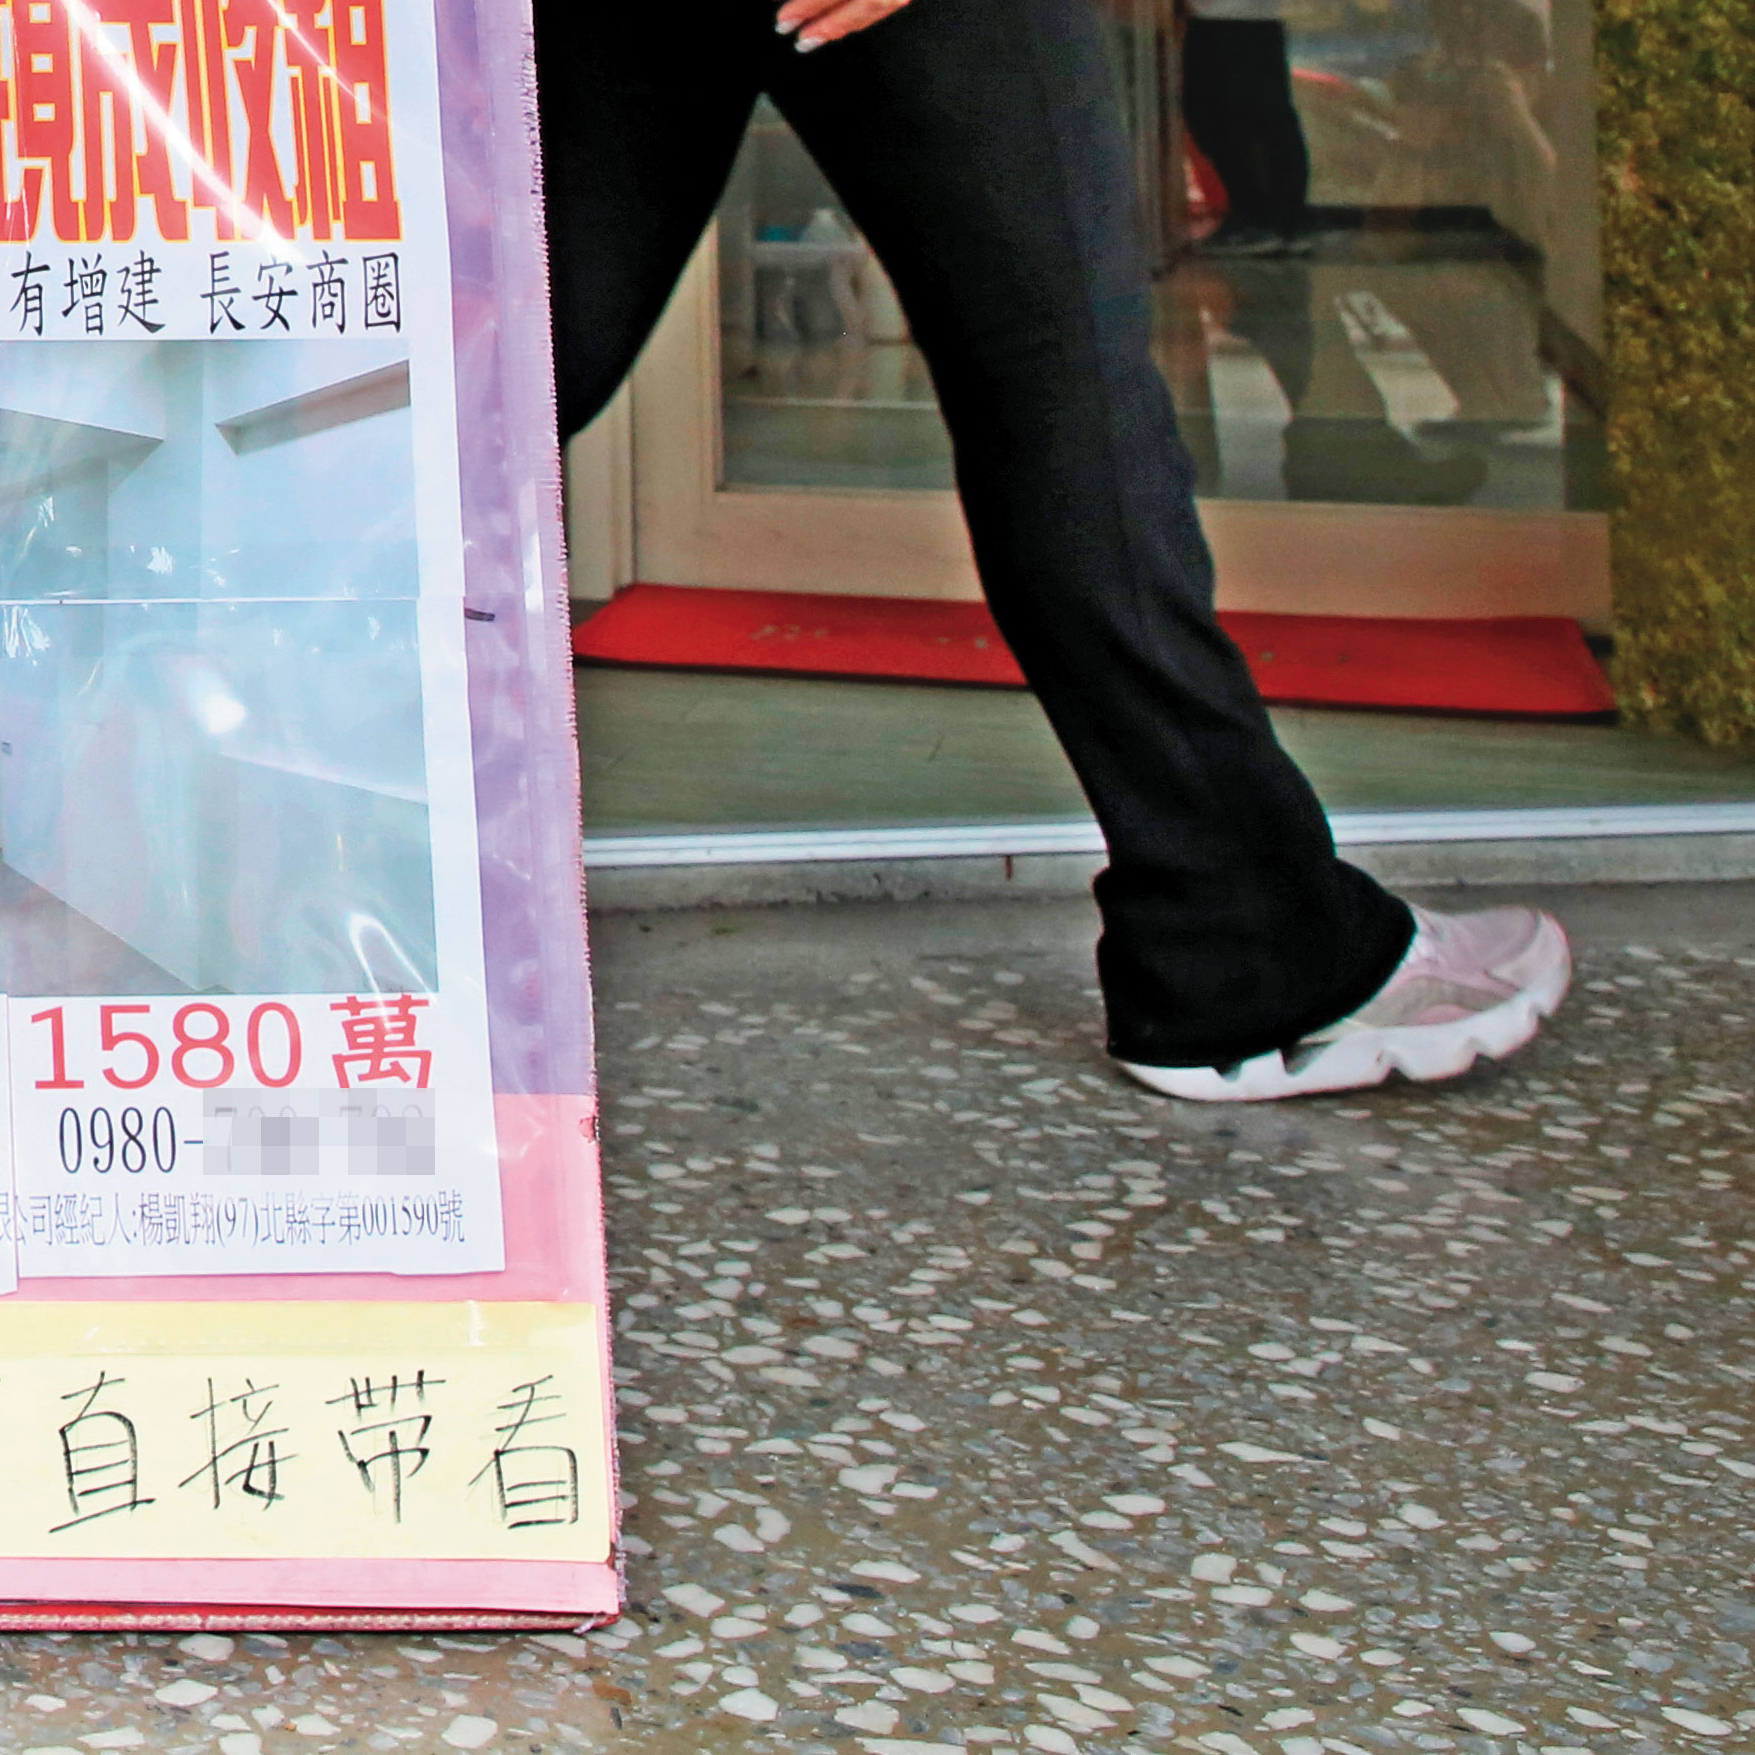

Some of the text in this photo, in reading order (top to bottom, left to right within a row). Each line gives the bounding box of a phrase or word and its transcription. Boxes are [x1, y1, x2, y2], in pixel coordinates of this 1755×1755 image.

[8, 254, 166, 340] 有增建
[198, 249, 404, 338] 長安商圈
